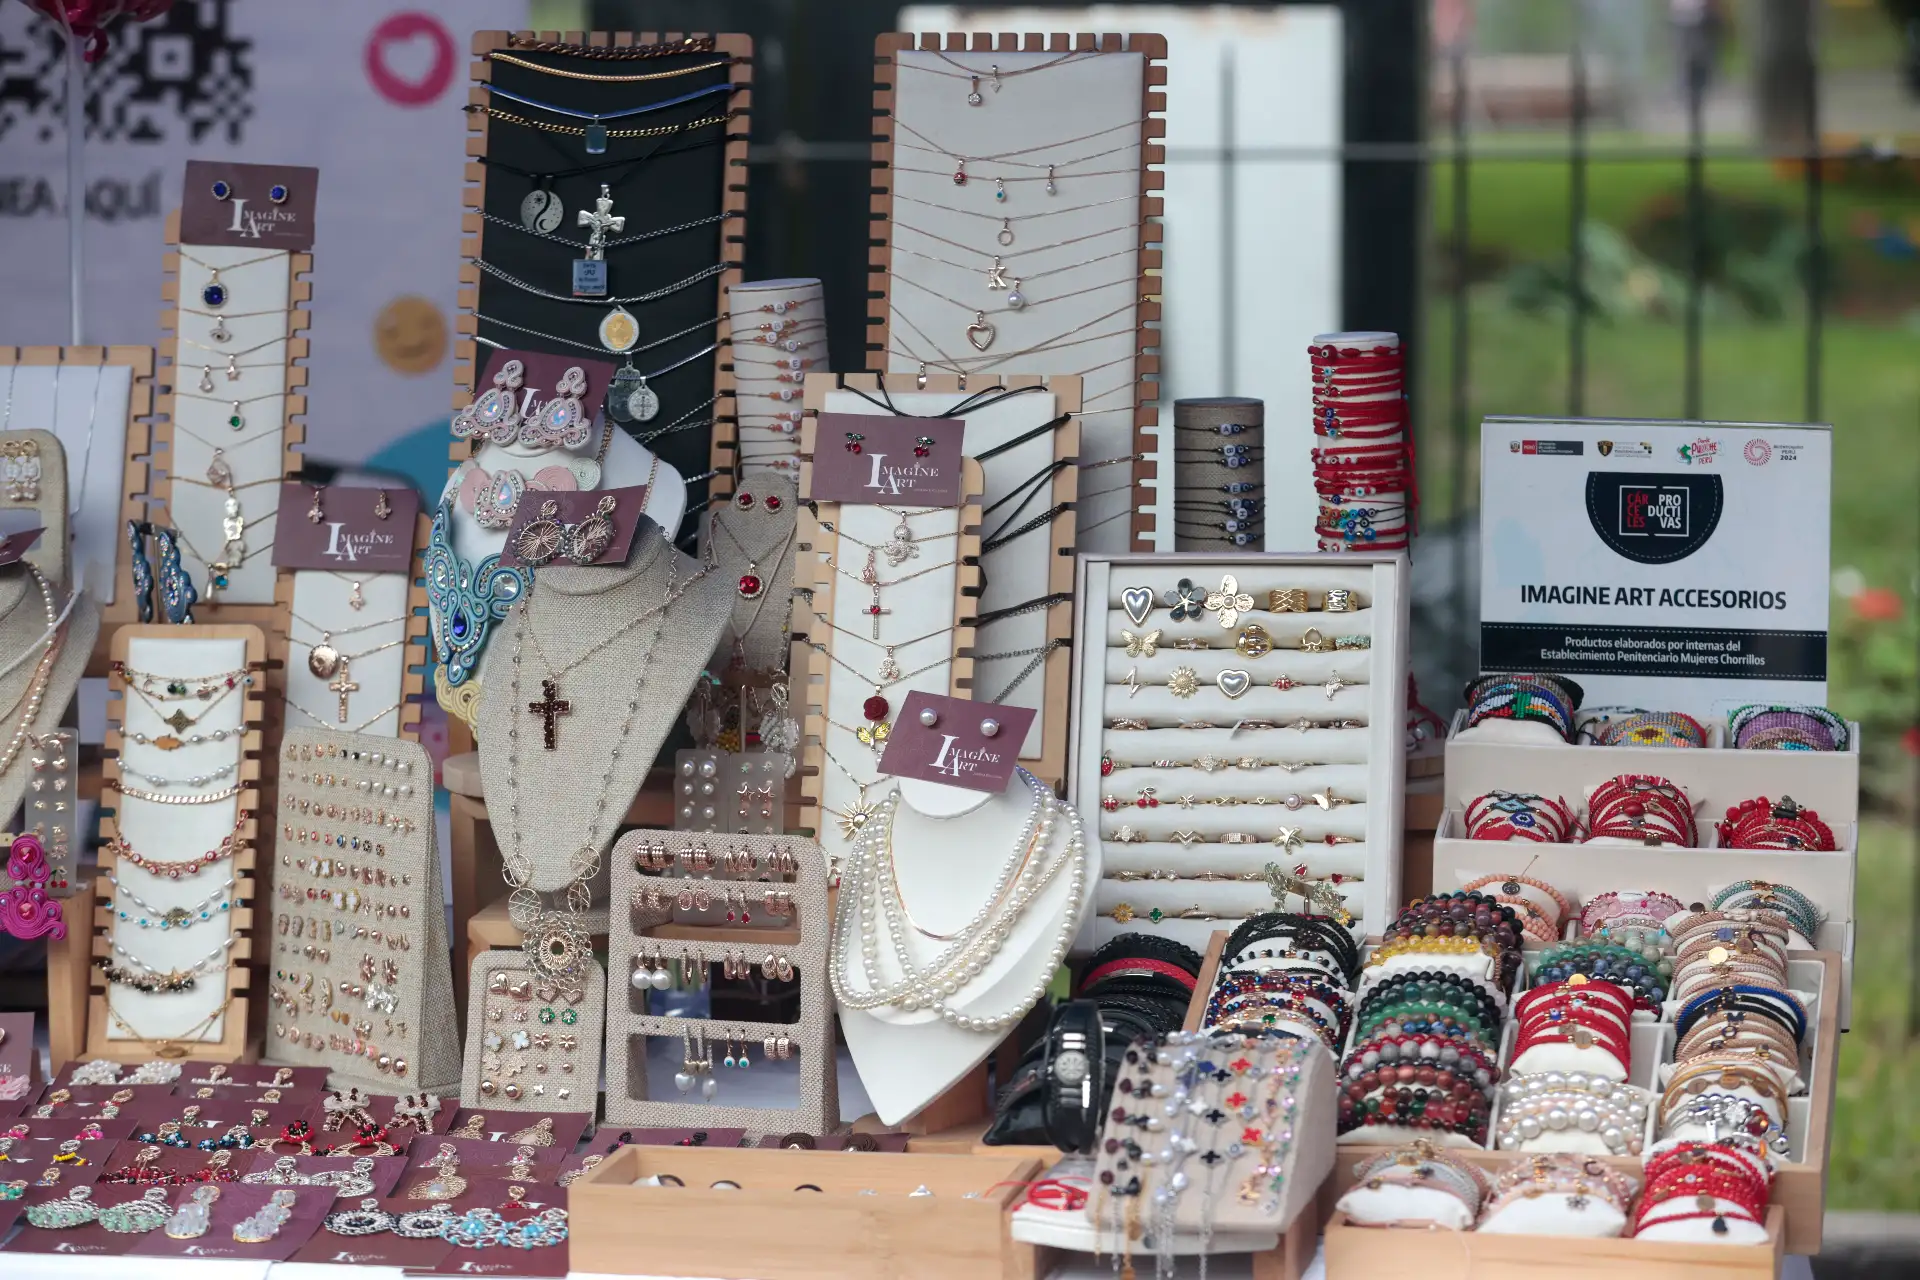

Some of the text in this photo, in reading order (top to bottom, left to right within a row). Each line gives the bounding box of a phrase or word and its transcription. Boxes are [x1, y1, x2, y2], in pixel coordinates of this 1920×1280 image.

[1658, 494, 1682, 506] PRO
[1647, 505, 1681, 517] DUCTI
[1660, 517, 1682, 529] VAS
[1520, 584, 1787, 610] IMAGINE ART ACCESORIOS
[1565, 636, 1741, 652] Productos elaborados por internas del
[1540, 649, 1766, 666] Establecimiento Penitenciario Mujeres Chorrillos
